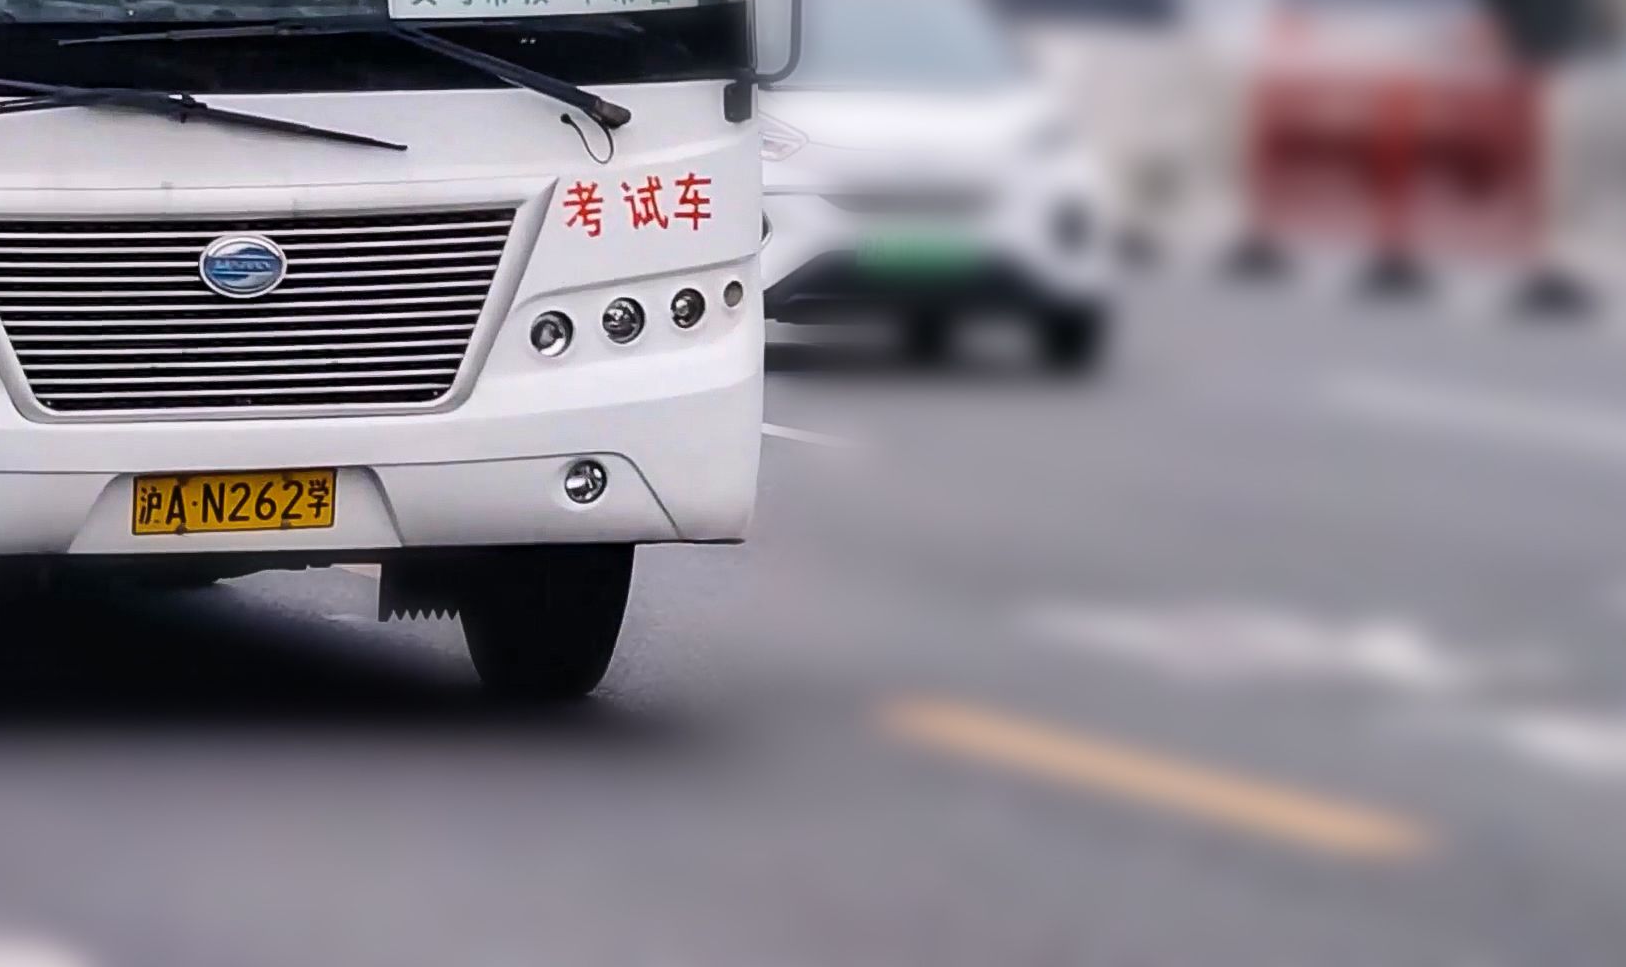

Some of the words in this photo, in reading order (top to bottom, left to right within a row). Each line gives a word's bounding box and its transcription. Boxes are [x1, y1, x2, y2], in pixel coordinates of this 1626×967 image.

[563, 172, 712, 238] 考试车
[138, 478, 330, 525] 沪A·N262学
